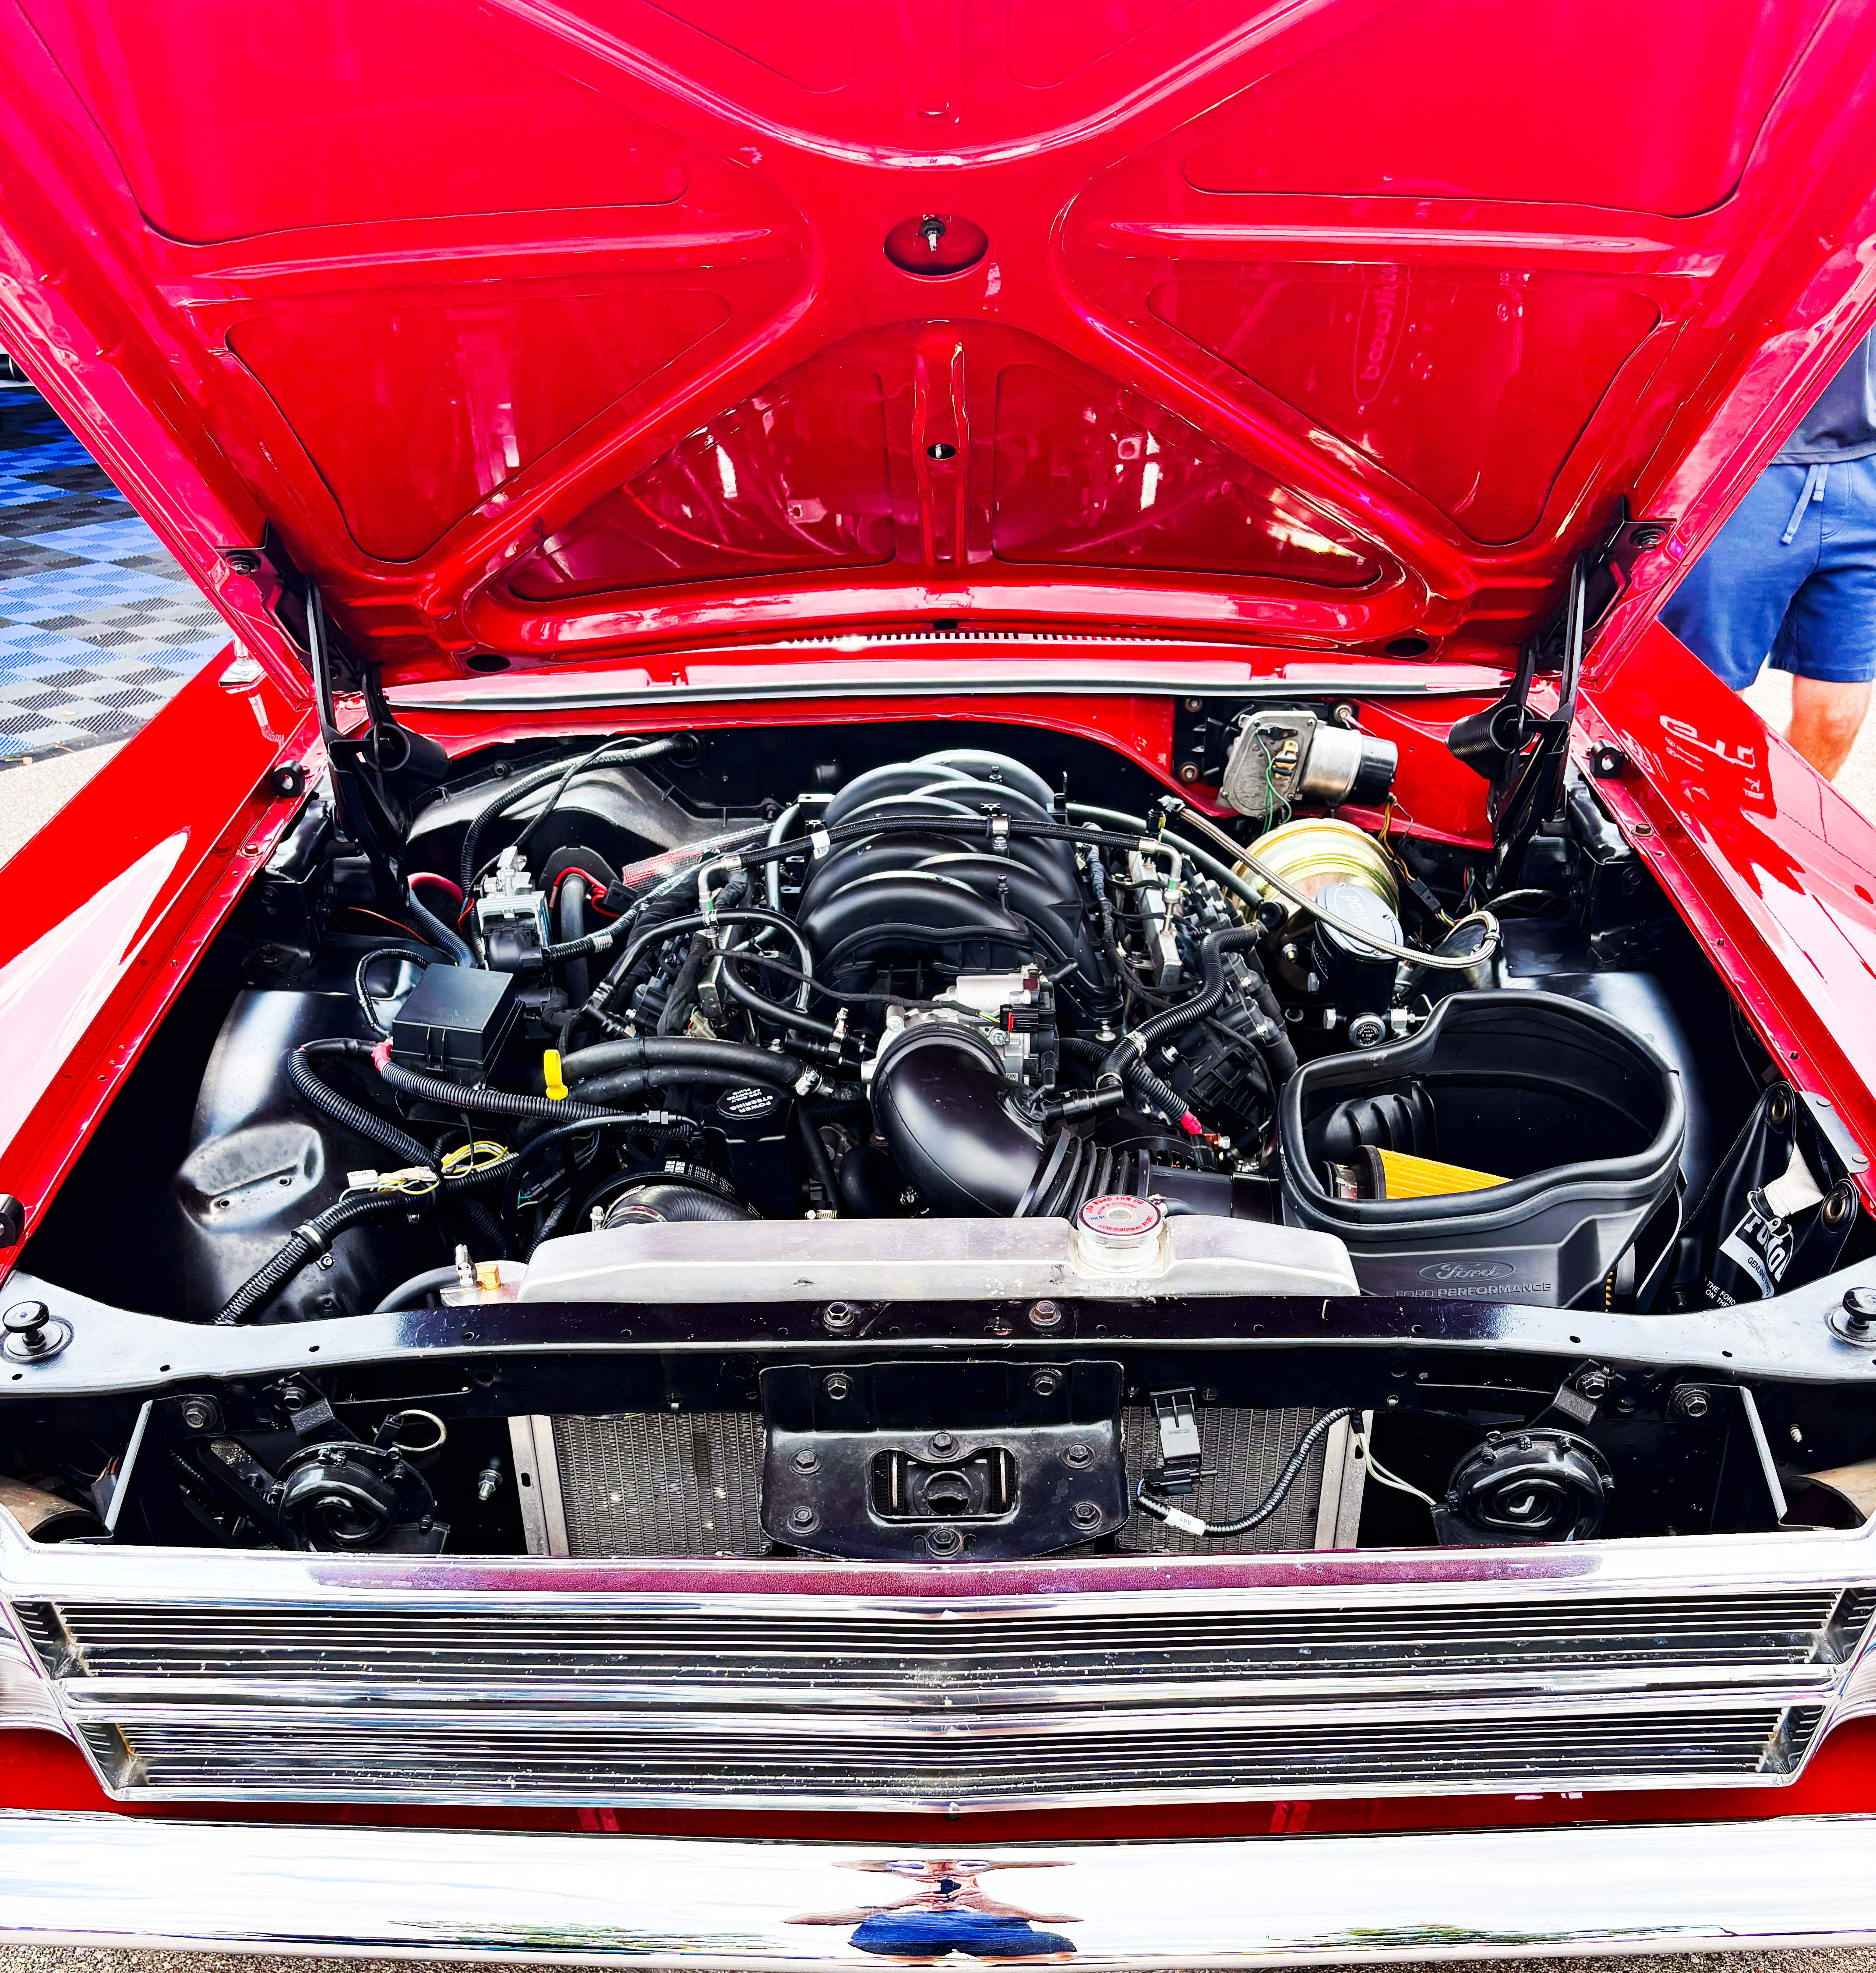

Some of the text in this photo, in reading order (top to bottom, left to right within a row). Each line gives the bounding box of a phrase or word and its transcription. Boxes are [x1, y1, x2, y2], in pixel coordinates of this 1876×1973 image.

[730, 1096, 773, 1110] STEERING
[739, 1101, 771, 1113] POWER
[1435, 1263, 1498, 1279] Ford
[1437, 1282, 1552, 1297] PERFORMANCE
[1706, 1289, 1716, 1299] ON
[1707, 1280, 1736, 1305] THE FORD
